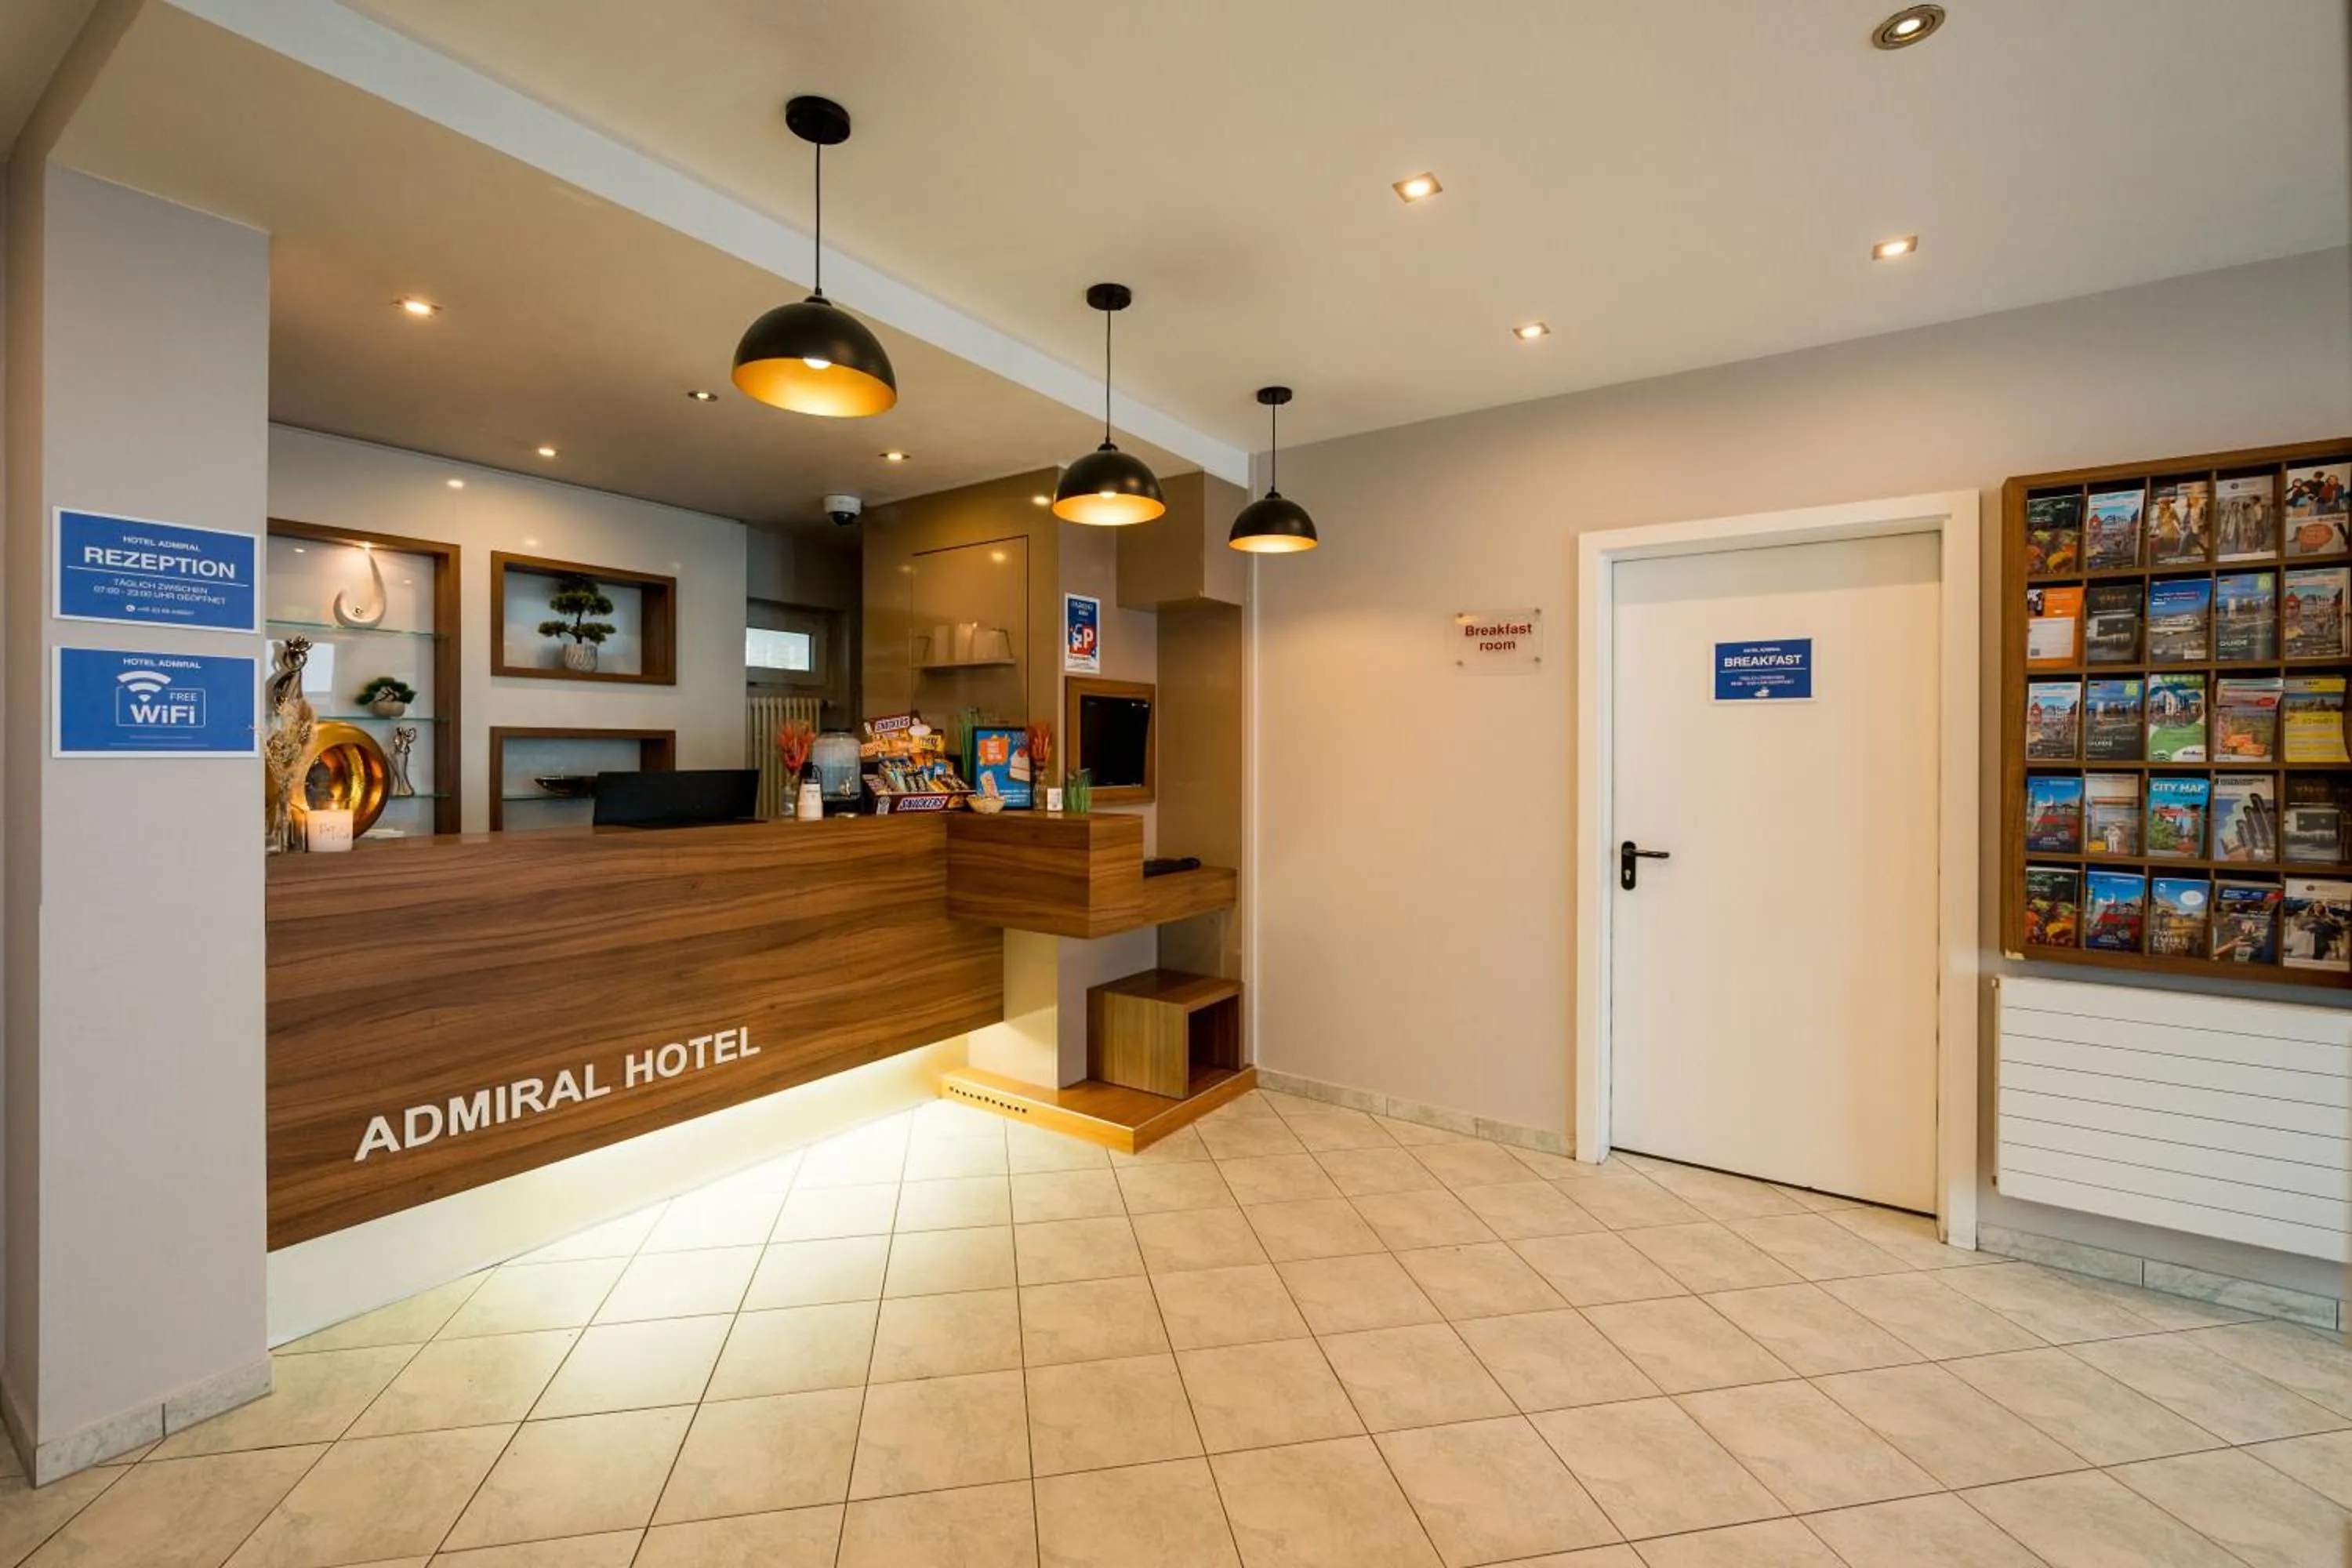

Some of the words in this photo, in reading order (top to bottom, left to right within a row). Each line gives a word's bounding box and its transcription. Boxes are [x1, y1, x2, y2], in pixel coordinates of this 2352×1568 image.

[122, 535, 156, 546] HOTEL
[158, 539, 202, 552] ADMIRAL
[84, 546, 235, 579] REZEPTION
[1465, 623, 1532, 637] Breakfast
[1479, 641, 1515, 651] room
[122, 658, 156, 666] HOTEL
[1724, 655, 1802, 667] BREAKFAST
[169, 691, 198, 702] FREE
[129, 704, 195, 724] WiFi
[354, 1064, 611, 1162] ADMIRAL
[626, 1026, 760, 1088] HOTEL
